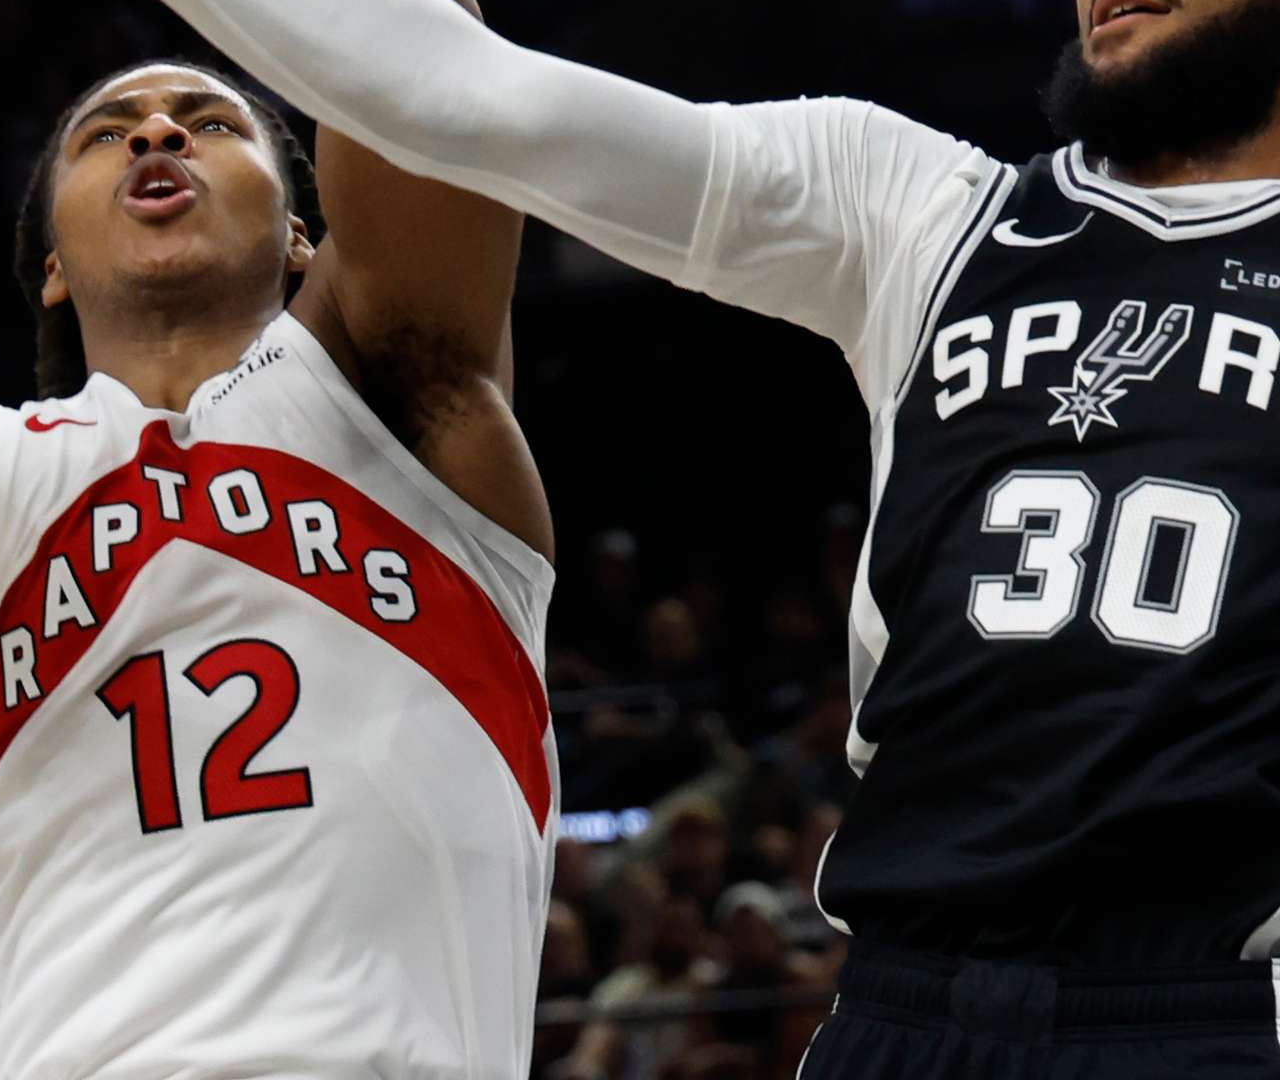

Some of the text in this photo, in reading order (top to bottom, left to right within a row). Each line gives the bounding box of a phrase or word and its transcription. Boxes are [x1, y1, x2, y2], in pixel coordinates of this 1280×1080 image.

[246, 345, 287, 374] Life
[0, 464, 419, 710] RAPTORS
[966, 469, 1241, 655] 30
[96, 638, 314, 835] 12
